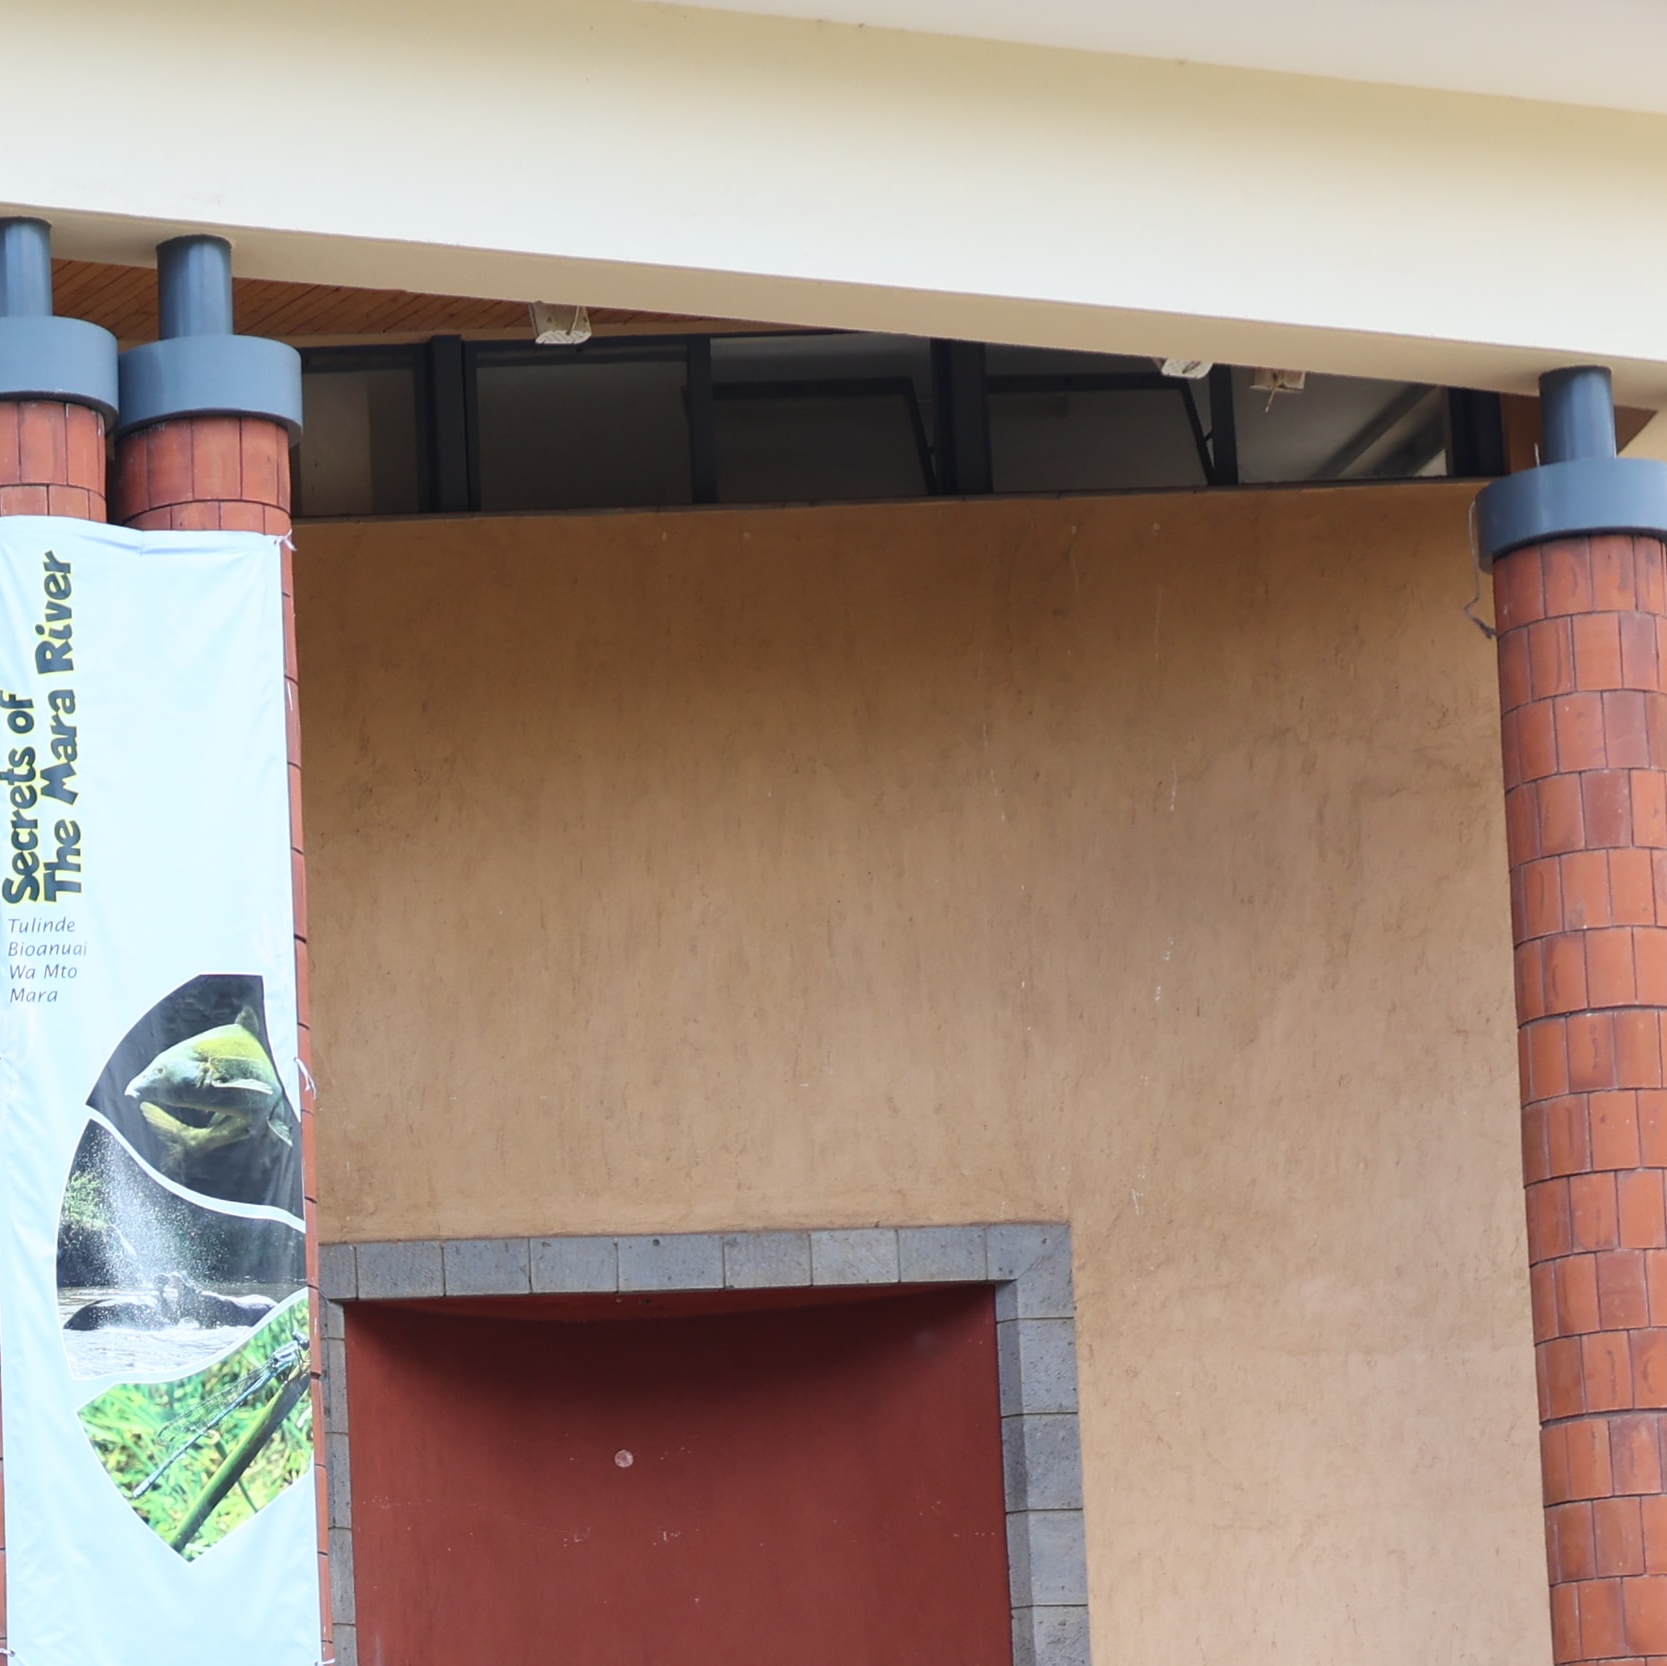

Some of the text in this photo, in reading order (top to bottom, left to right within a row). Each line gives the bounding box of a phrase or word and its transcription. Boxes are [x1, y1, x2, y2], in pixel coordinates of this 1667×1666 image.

[33, 549, 83, 904] The Mara River
[7, 916, 76, 934] Tulinde
[6, 939, 88, 958] Bioanuai
[8, 963, 78, 980] Wa Mto
[9, 986, 59, 1004] Mara
